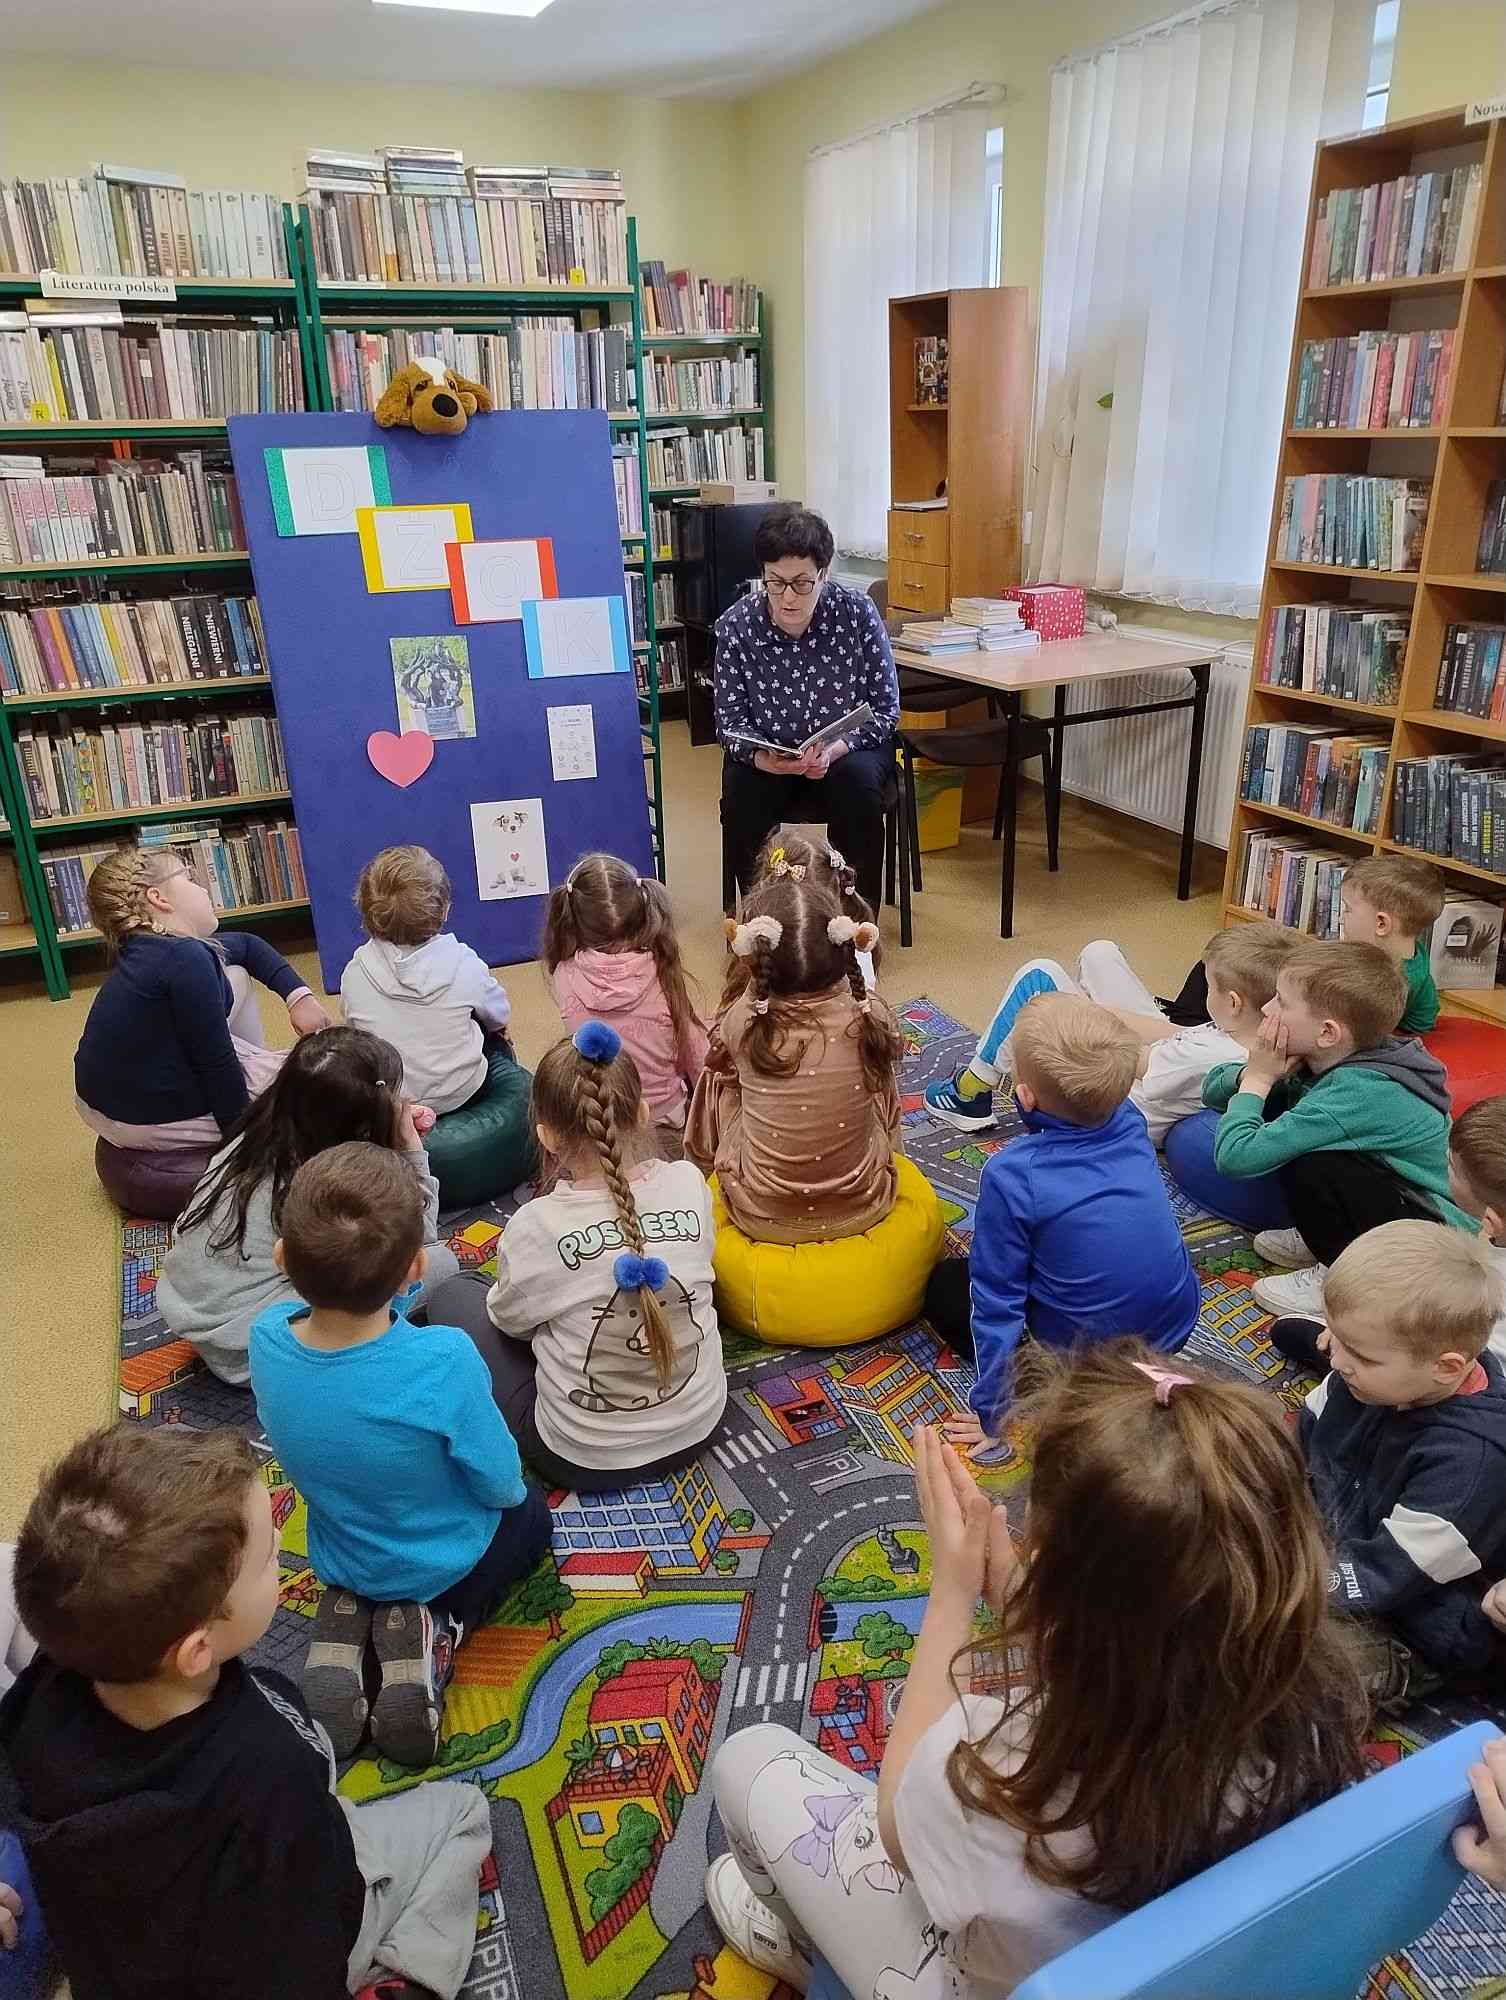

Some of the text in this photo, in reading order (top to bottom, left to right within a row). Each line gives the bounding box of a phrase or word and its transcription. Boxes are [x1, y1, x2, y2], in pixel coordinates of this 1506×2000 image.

[51, 277, 169, 296] Literatura polska
[181, 615, 201, 669] NIELEGALNI
[204, 614, 223, 664] NIEWIERNI
[552, 610, 602, 665] K
[558, 1210, 700, 1270] PUSEEN
